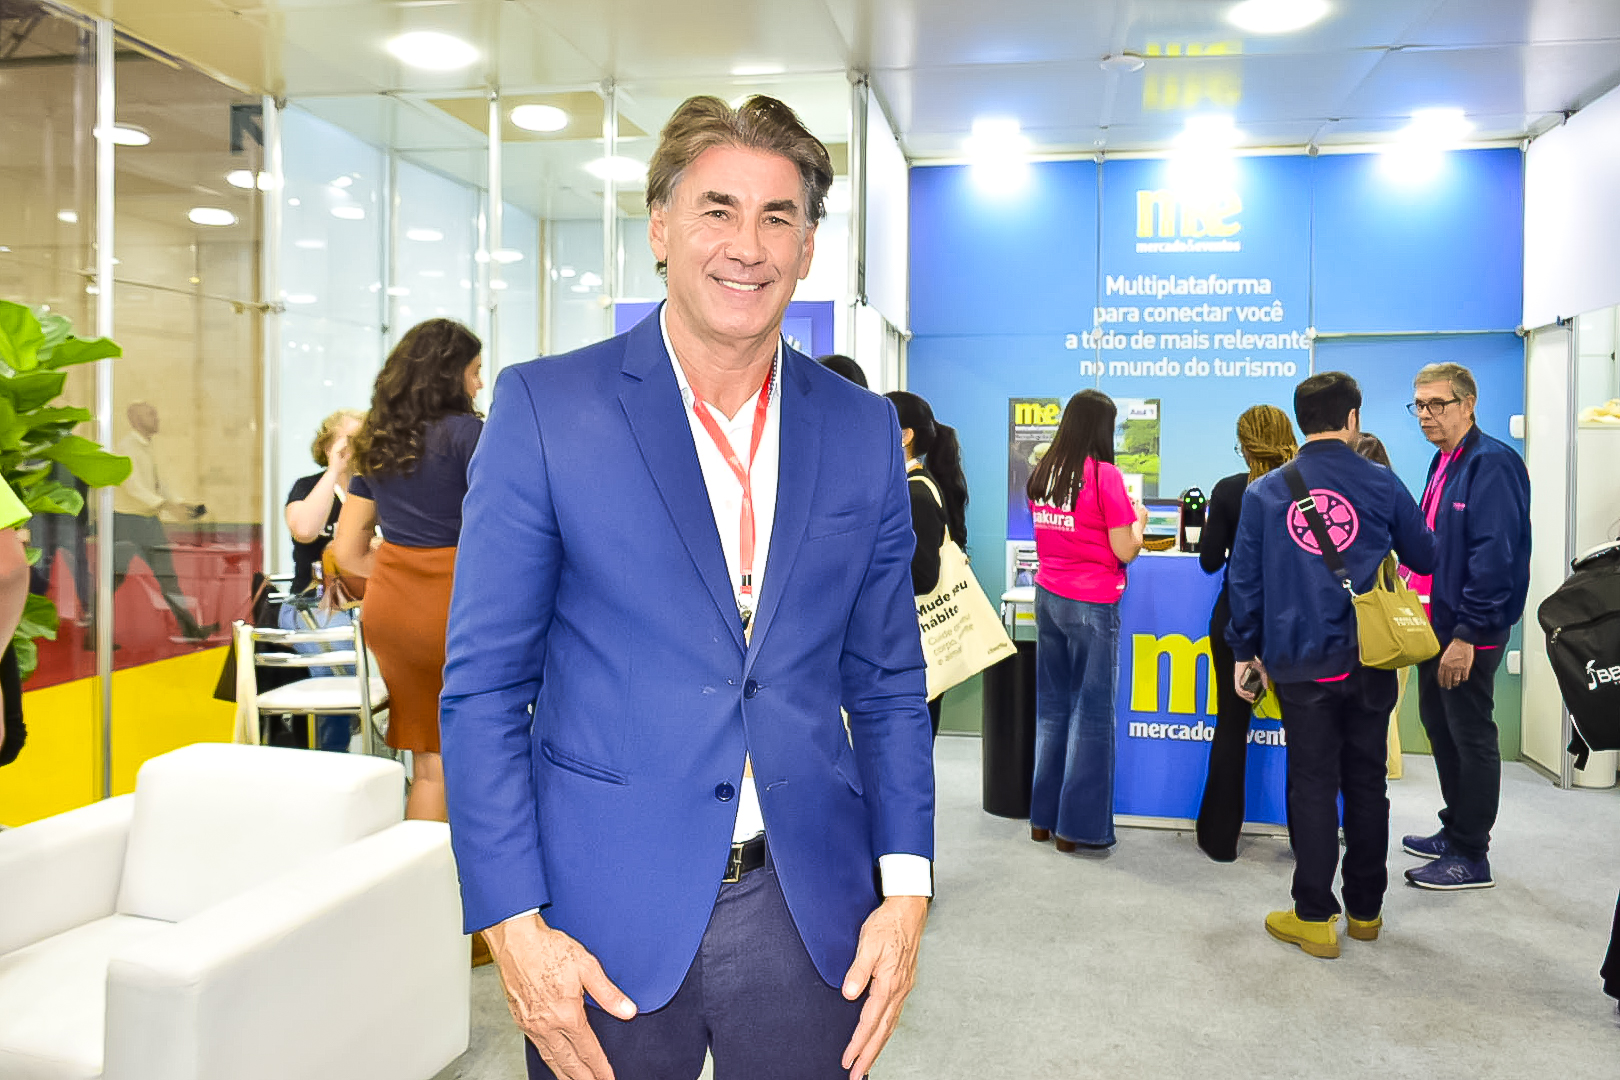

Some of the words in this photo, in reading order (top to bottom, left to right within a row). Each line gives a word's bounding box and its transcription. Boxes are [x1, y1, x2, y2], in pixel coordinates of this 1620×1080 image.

[1106, 274, 1272, 300] Multiplataforma
[1093, 306, 1140, 327] para
[1143, 303, 1232, 322] conectar
[1236, 300, 1284, 322] você
[1065, 335, 1078, 350] a
[1130, 330, 1156, 350] de
[1160, 330, 1210, 350] mais
[1213, 330, 1310, 350] relevante
[1080, 359, 1104, 376] no
[1108, 357, 1180, 377] mundo
[1184, 357, 1210, 377] do
[1213, 357, 1297, 377] turismo
